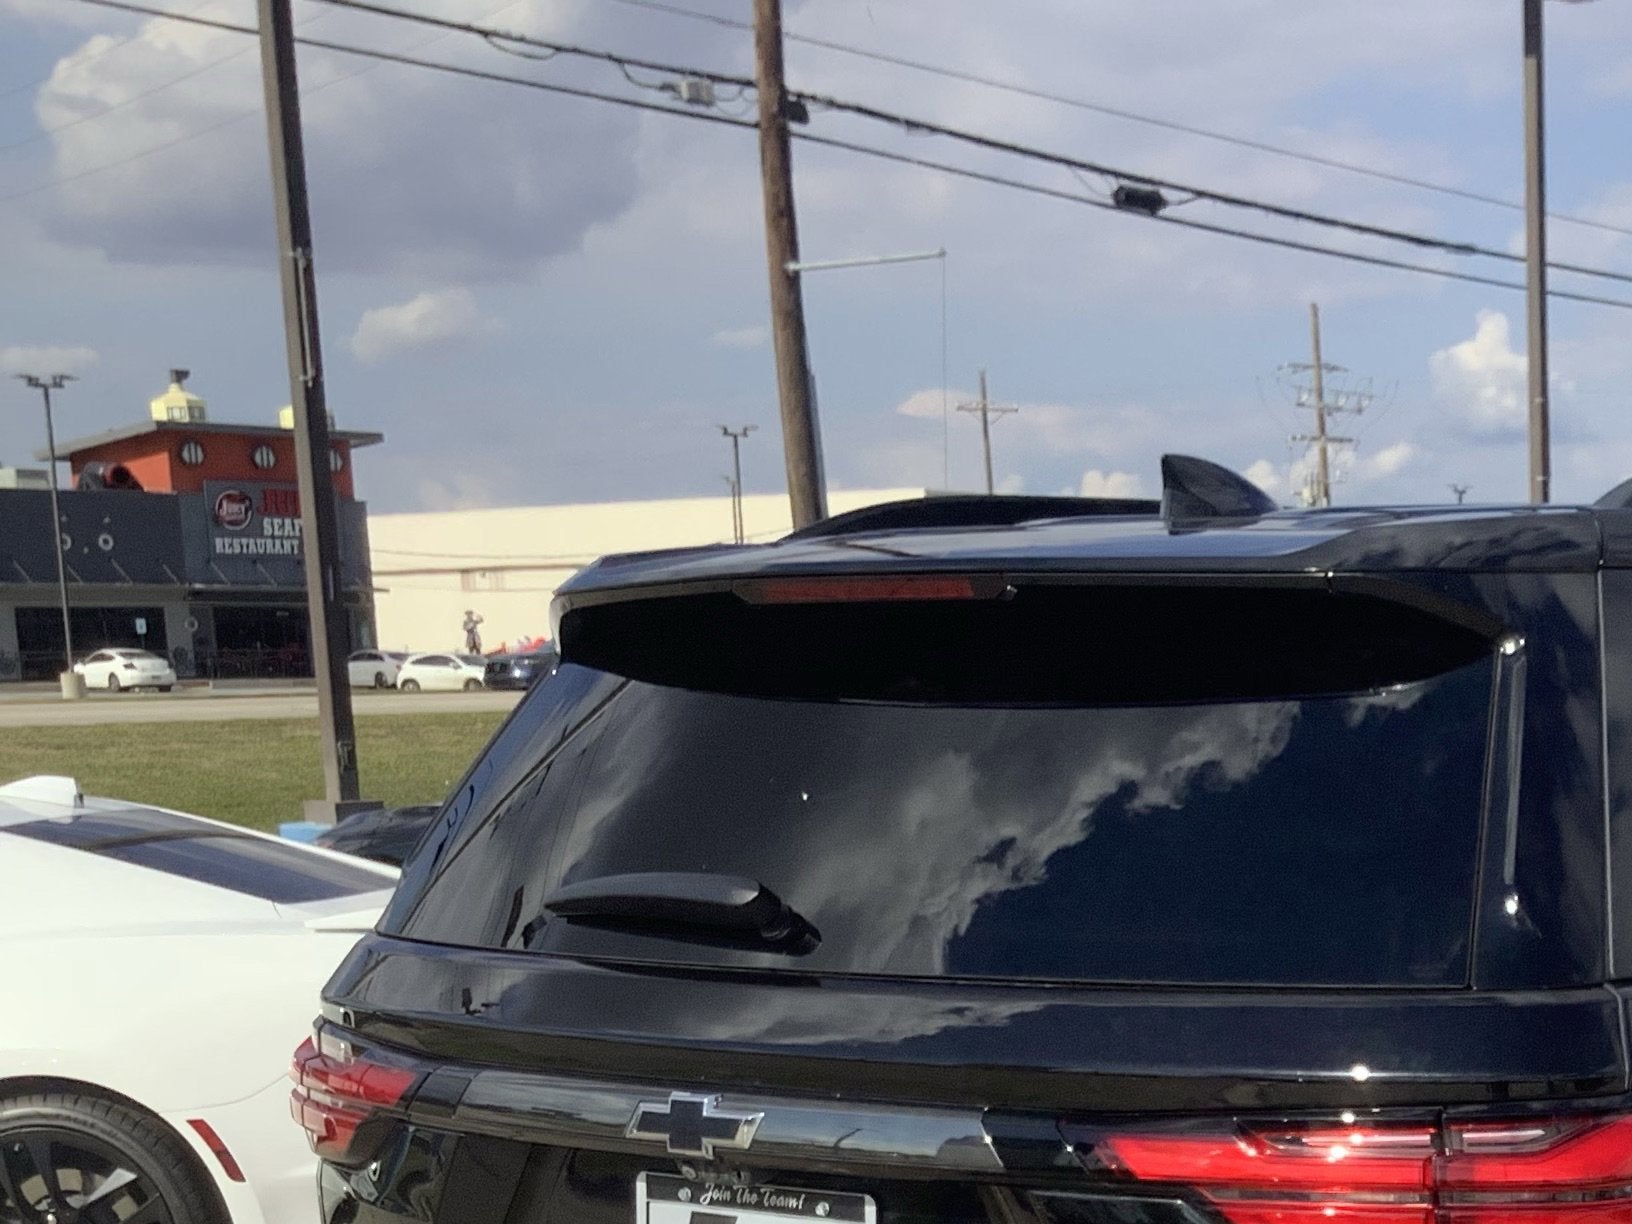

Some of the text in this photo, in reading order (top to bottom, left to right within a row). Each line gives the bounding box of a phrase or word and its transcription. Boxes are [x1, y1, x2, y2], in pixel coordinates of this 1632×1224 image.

[263, 517, 302, 537] SEAF
[215, 536, 299, 555] RESTAURANT
[699, 1182, 731, 1205] Join
[732, 1185, 758, 1205] The
